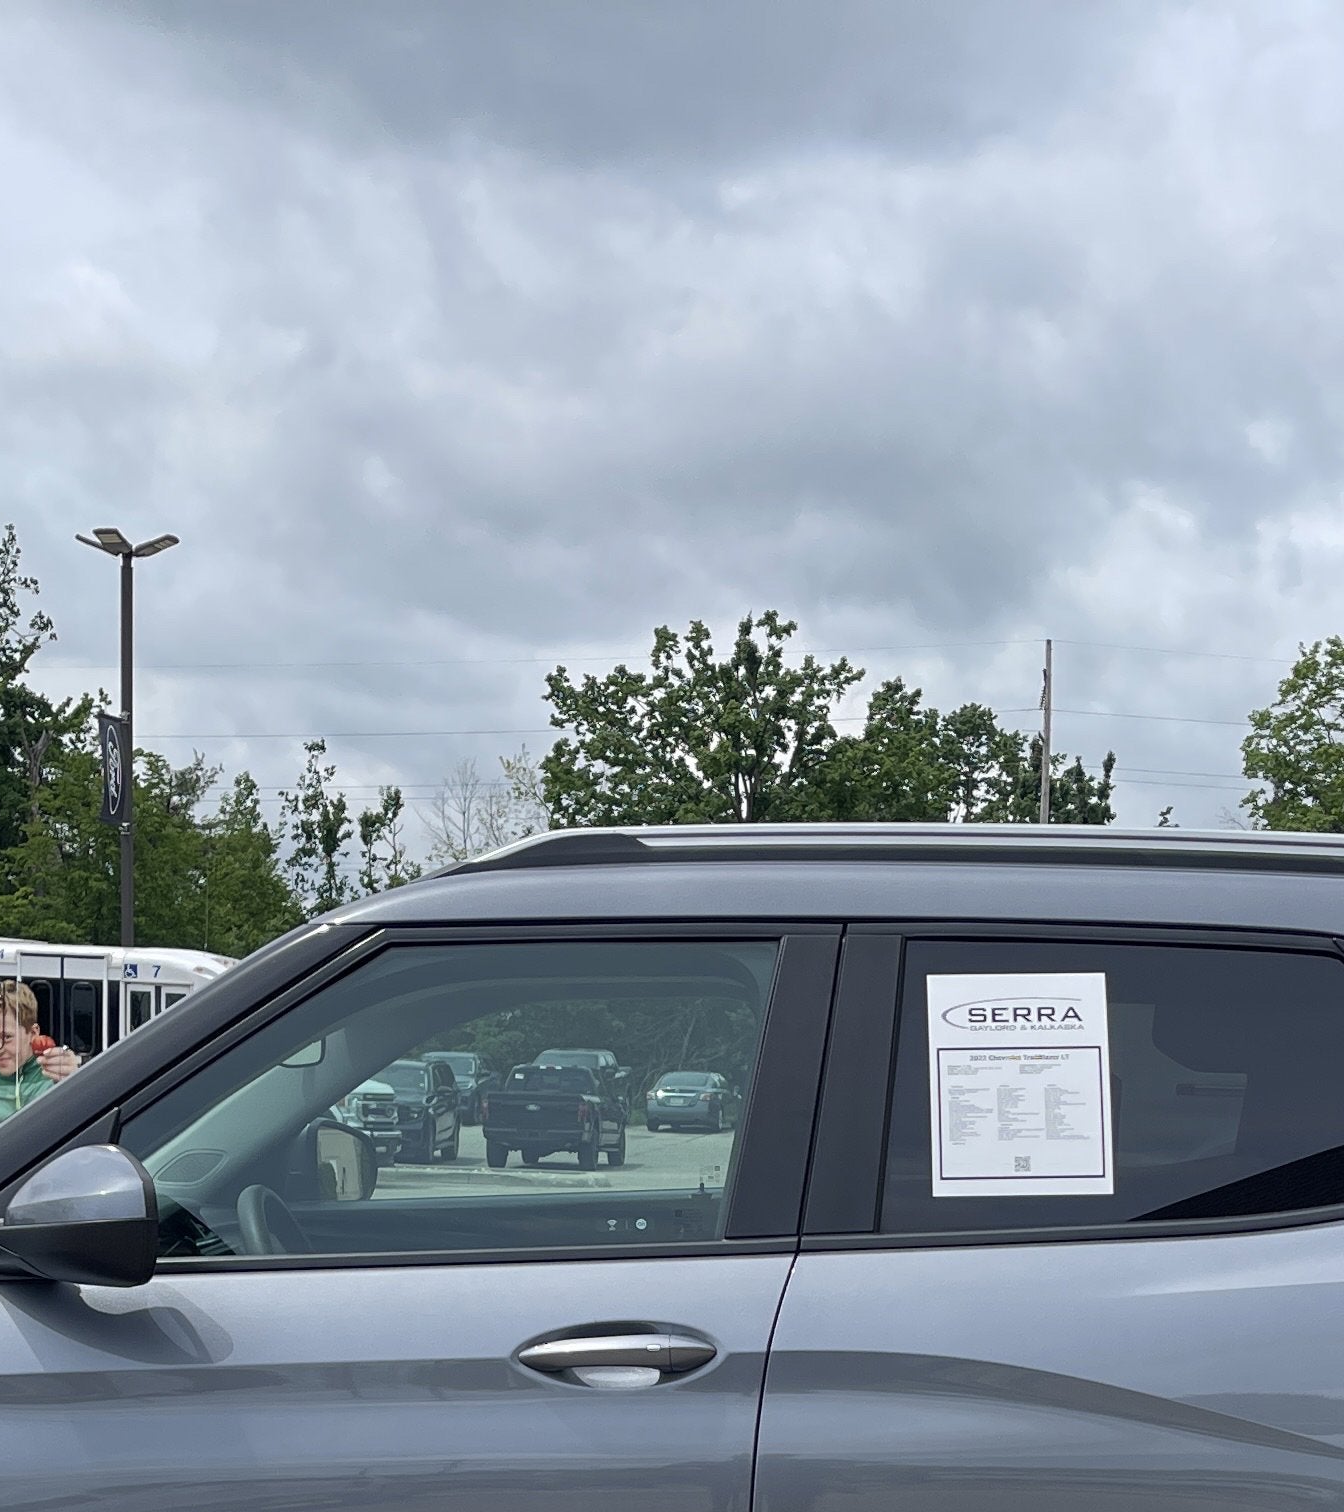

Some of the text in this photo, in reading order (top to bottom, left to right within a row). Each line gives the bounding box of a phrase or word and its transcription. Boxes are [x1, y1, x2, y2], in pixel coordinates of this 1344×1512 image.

[152, 964, 161, 978] 7
[968, 1006, 1083, 1023] SERRA
[969, 1024, 1017, 1032] GAYLORD
